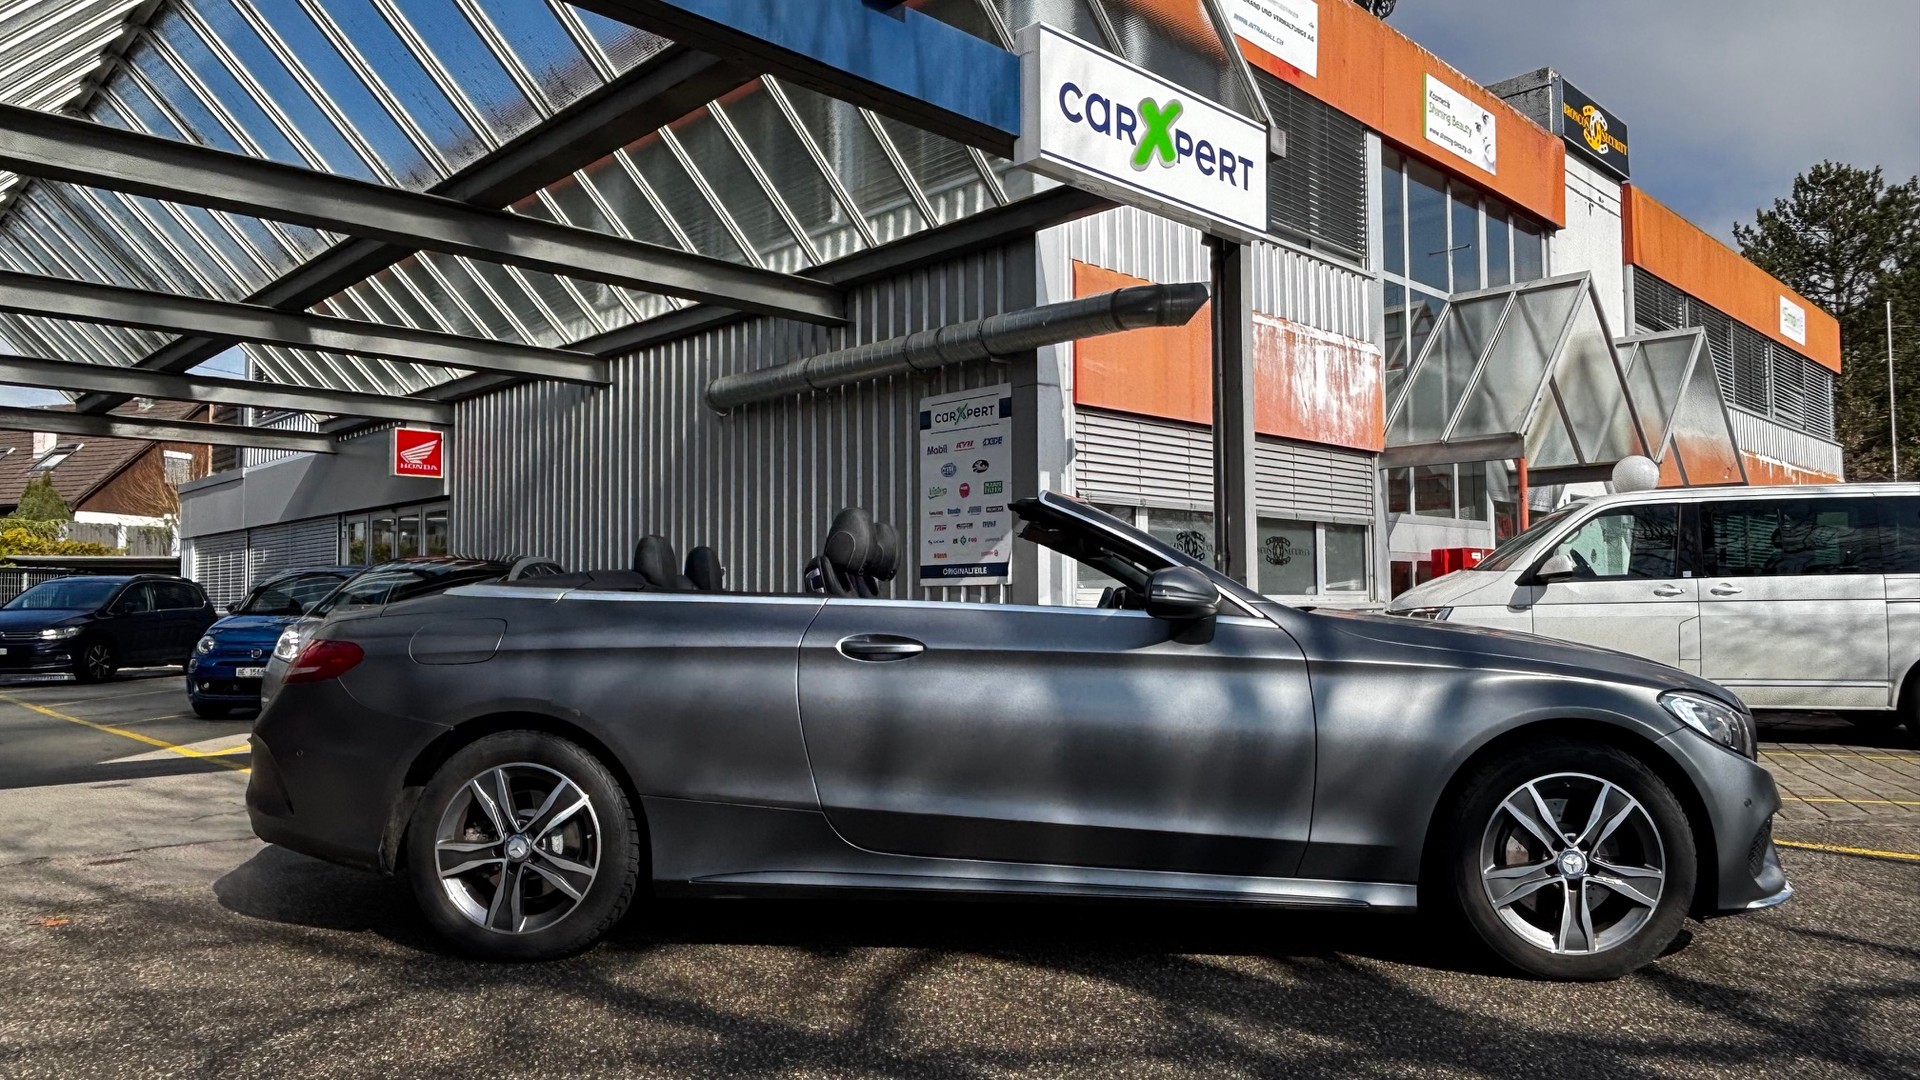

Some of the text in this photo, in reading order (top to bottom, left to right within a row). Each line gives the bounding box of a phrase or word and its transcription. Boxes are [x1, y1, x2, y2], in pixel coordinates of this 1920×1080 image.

[927, 444, 948, 456] Mobil
[400, 462, 438, 471] HONDA
[942, 566, 988, 576] ORIGINALTEILE
